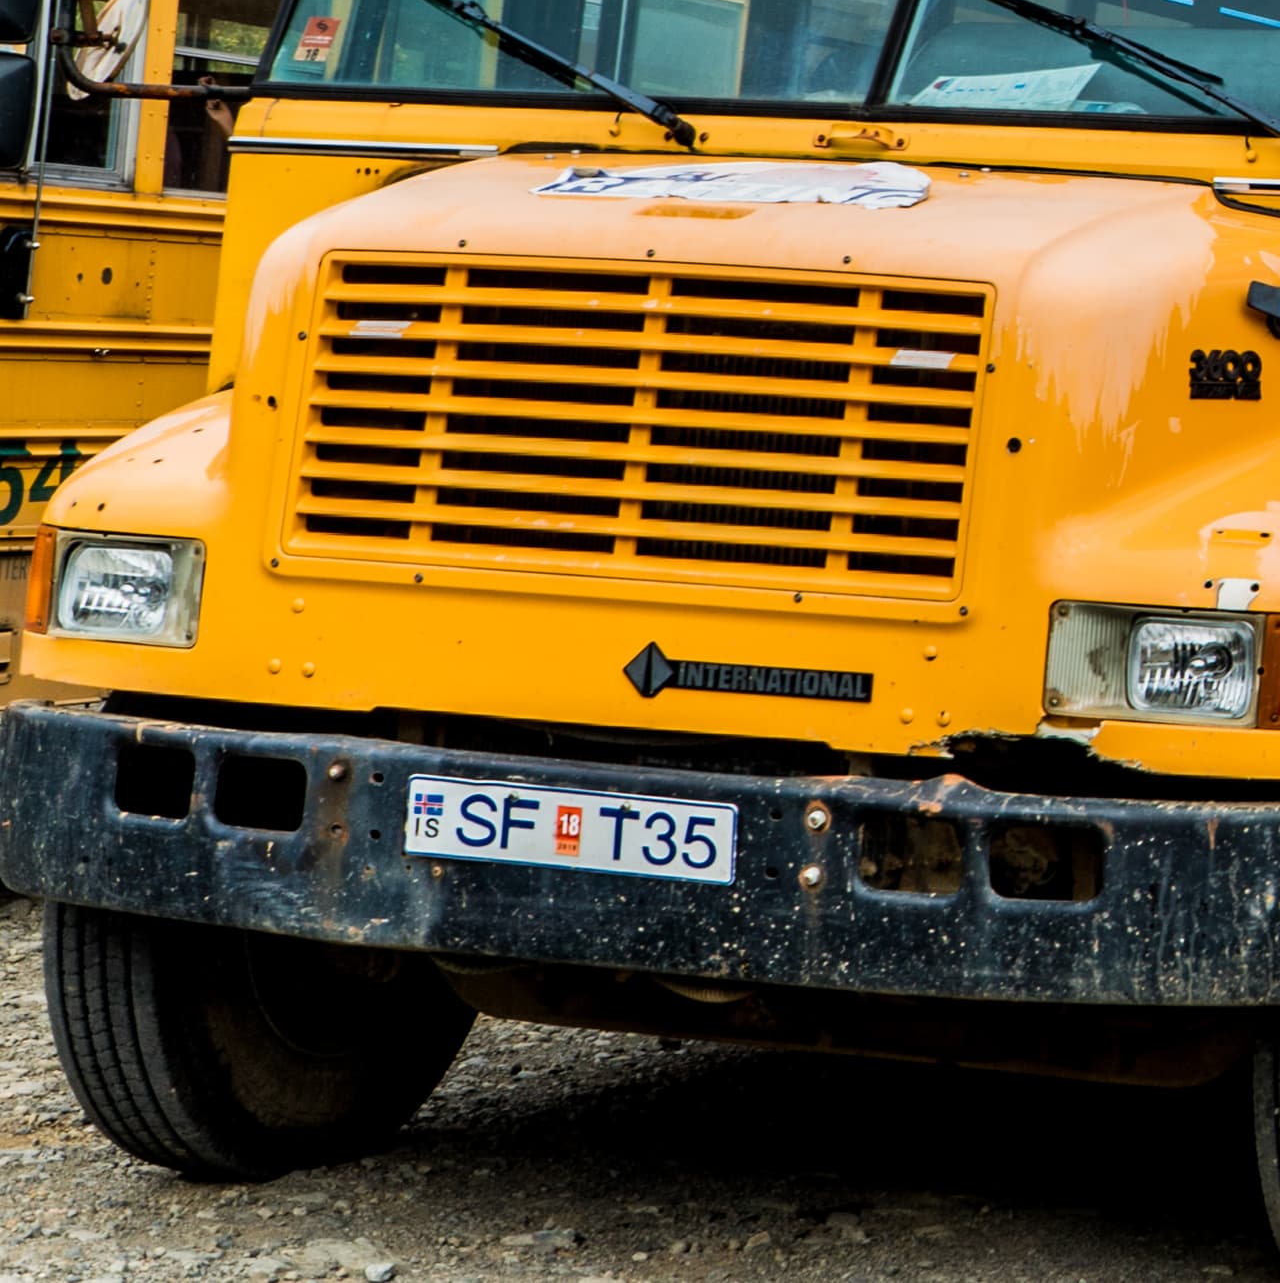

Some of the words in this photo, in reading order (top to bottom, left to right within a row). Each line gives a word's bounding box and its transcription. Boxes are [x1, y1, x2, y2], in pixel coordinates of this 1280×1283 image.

[678, 662, 867, 699] INTERNATIONAL
[414, 817, 440, 838] IS
[456, 793, 540, 849] SF
[599, 806, 717, 869] T35
[560, 813, 580, 836] 18
